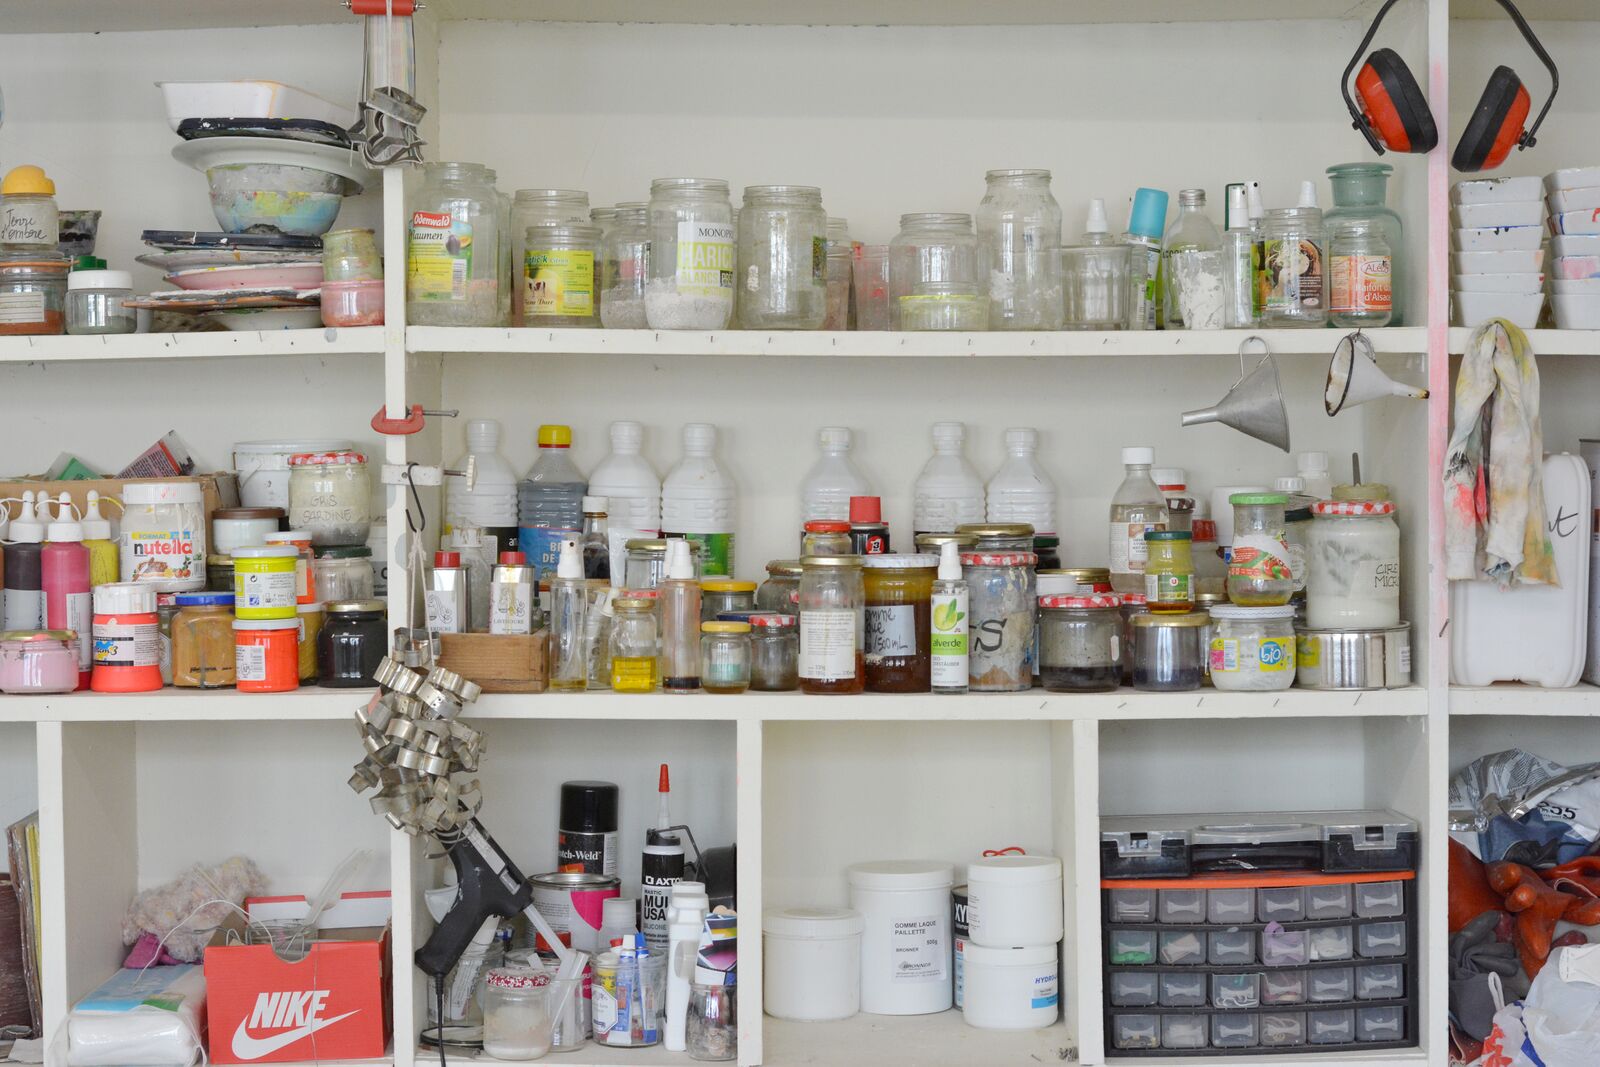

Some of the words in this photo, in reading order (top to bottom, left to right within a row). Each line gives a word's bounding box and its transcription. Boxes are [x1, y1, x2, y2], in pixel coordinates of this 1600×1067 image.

[413, 213, 451, 227] Odenwald
[134, 539, 193, 555] nutella
[932, 638, 962, 648] alverde
[1260, 646, 1281, 664] bio
[919, 920, 936, 928] LAQUE
[248, 990, 330, 1028] NIKE
